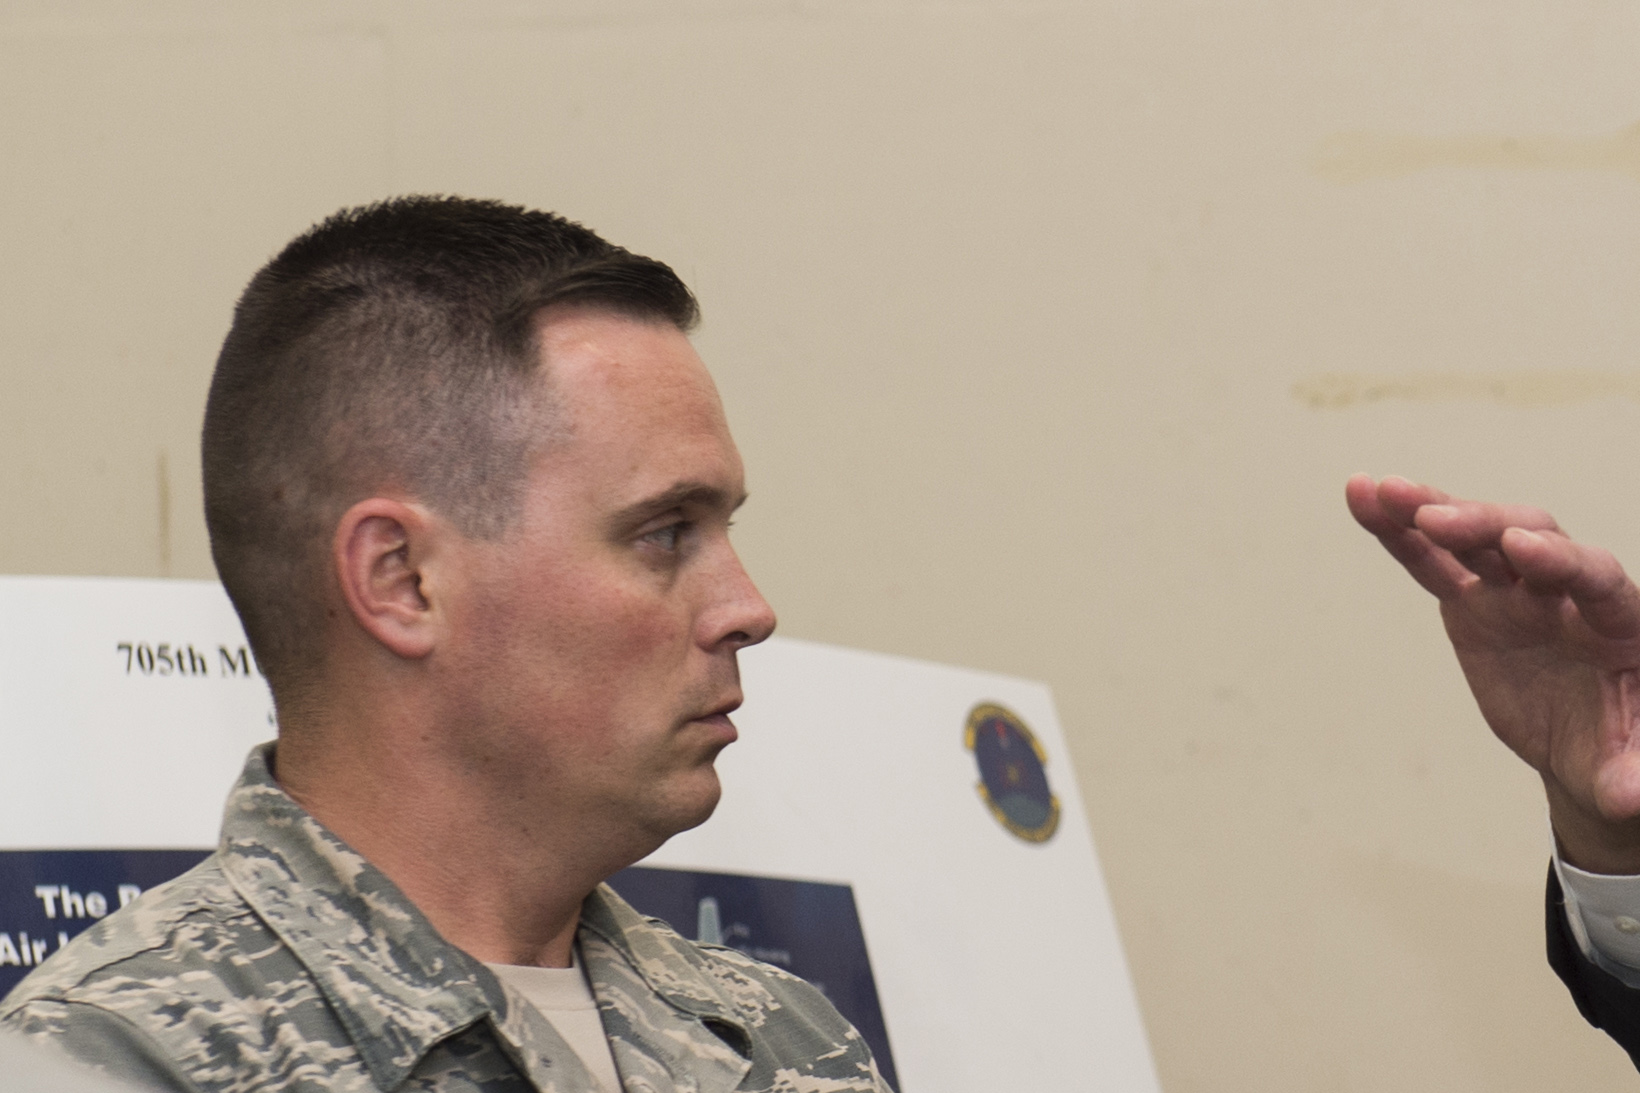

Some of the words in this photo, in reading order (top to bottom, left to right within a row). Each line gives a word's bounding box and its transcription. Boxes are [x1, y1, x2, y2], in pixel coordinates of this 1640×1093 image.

[117, 643, 207, 676] 705th
[218, 645, 259, 678] M
[35, 884, 108, 919] The
[0, 931, 47, 966] Air
